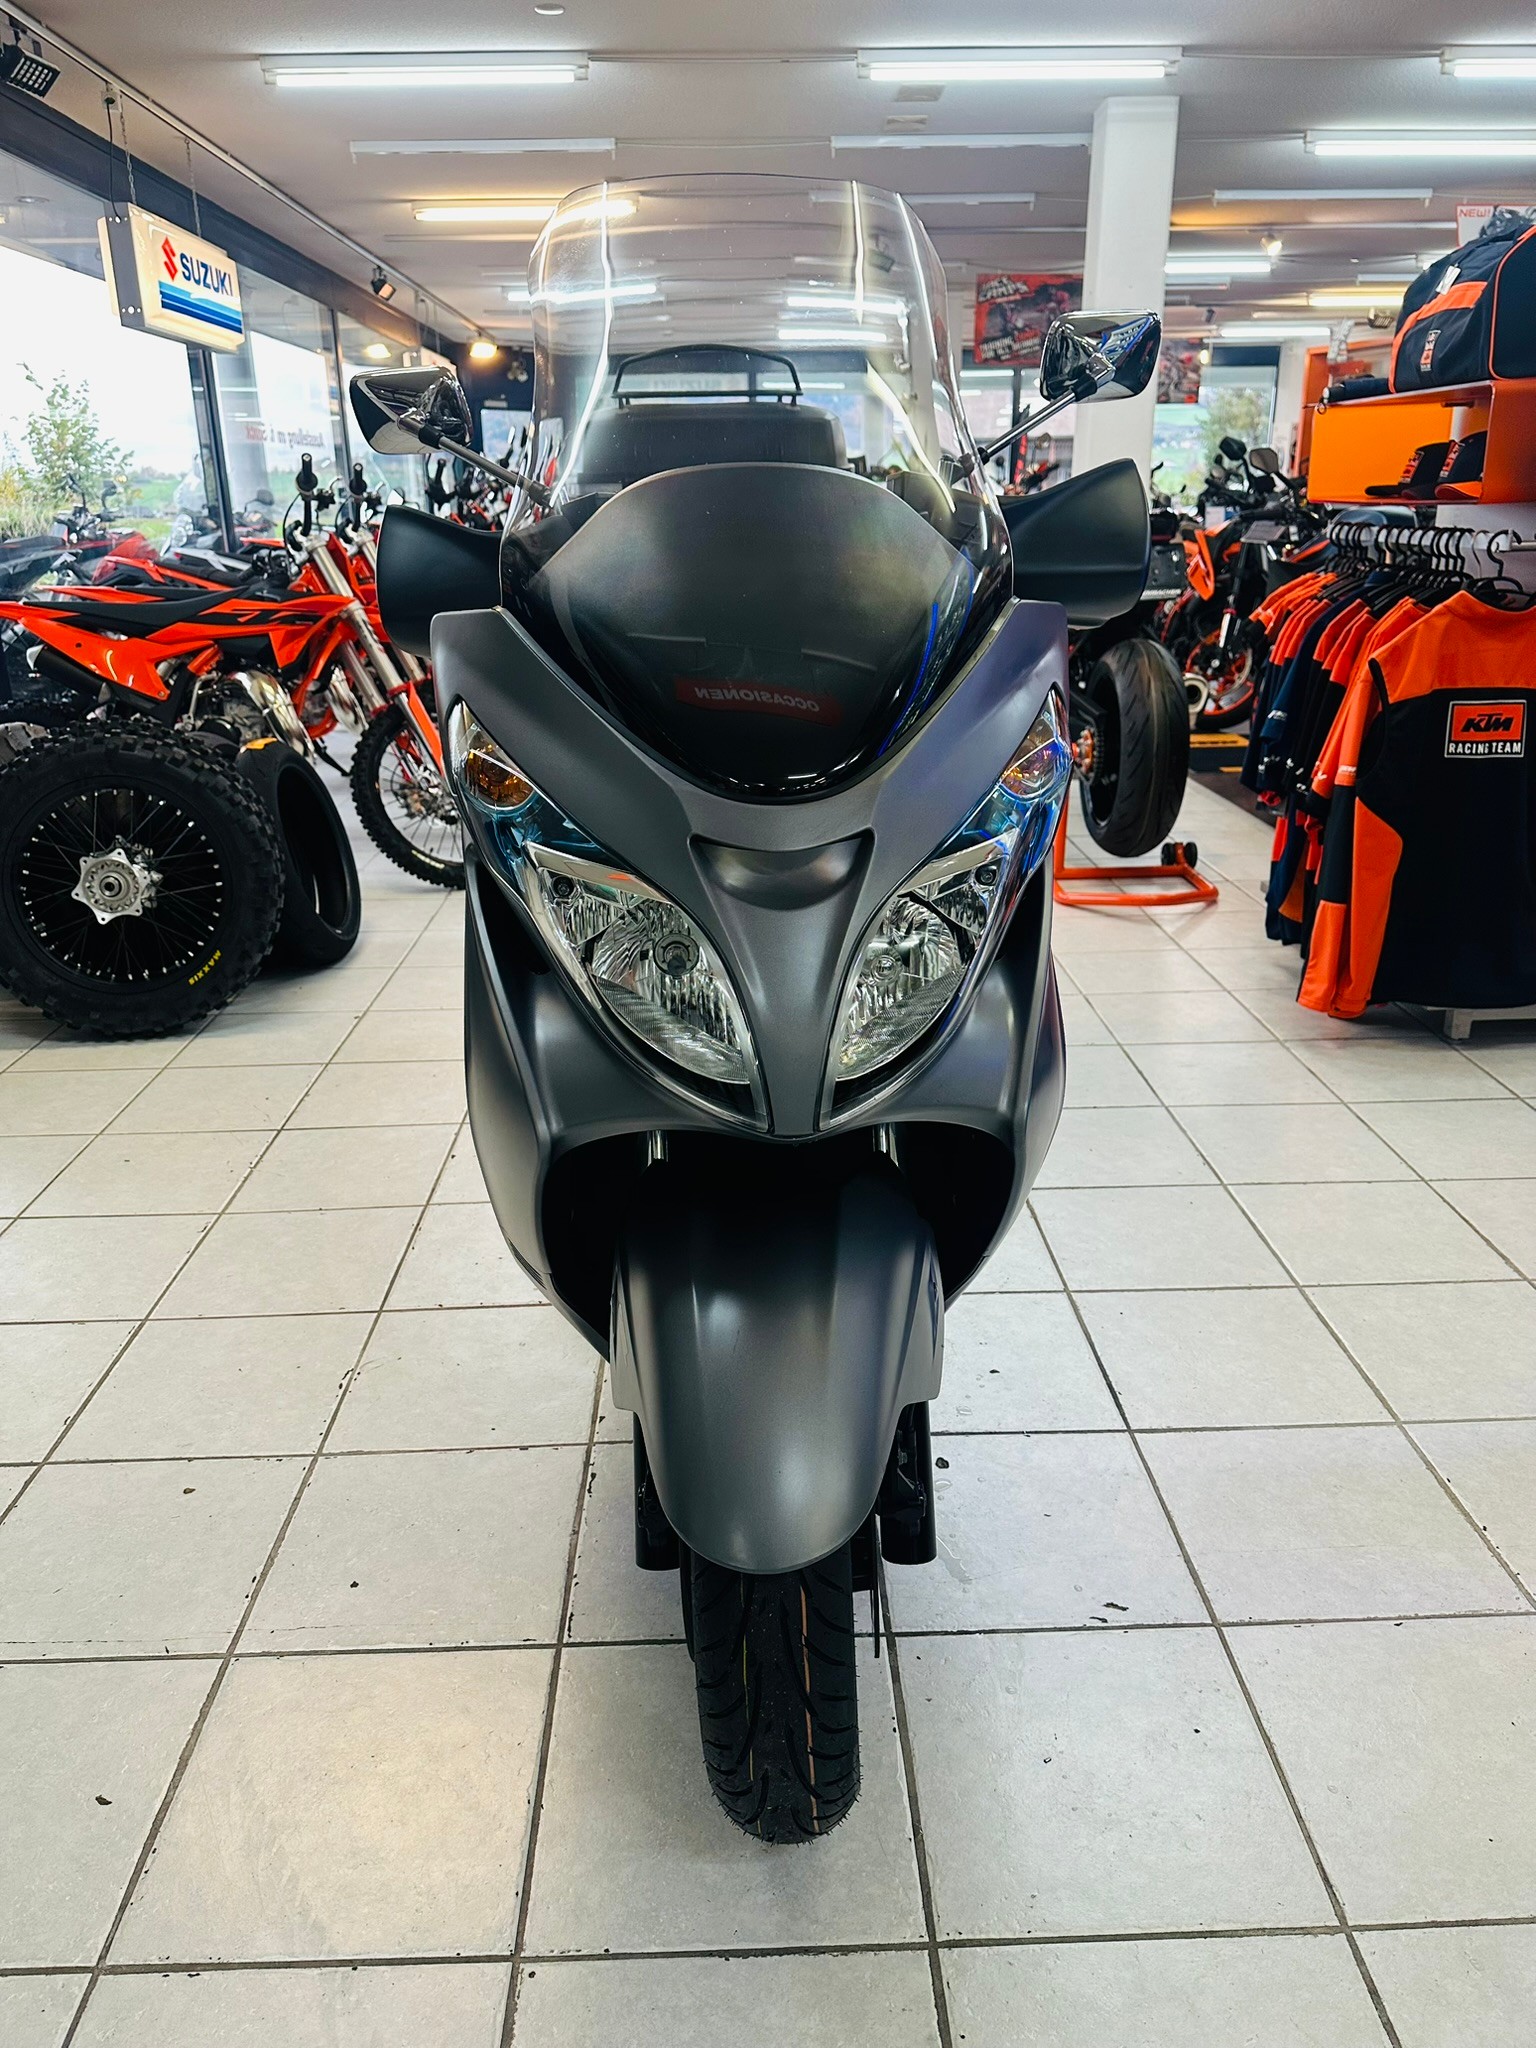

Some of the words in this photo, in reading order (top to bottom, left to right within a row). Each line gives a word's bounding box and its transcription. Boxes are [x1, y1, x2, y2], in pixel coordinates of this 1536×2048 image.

[1459, 208, 1491, 219] NEW!
[181, 254, 234, 296] SUZUKI
[1461, 713, 1514, 733] KTM
[1448, 742, 1489, 754] RACING
[1492, 741, 1522, 754] TEAM
[188, 949, 222, 986] MAXXIS
